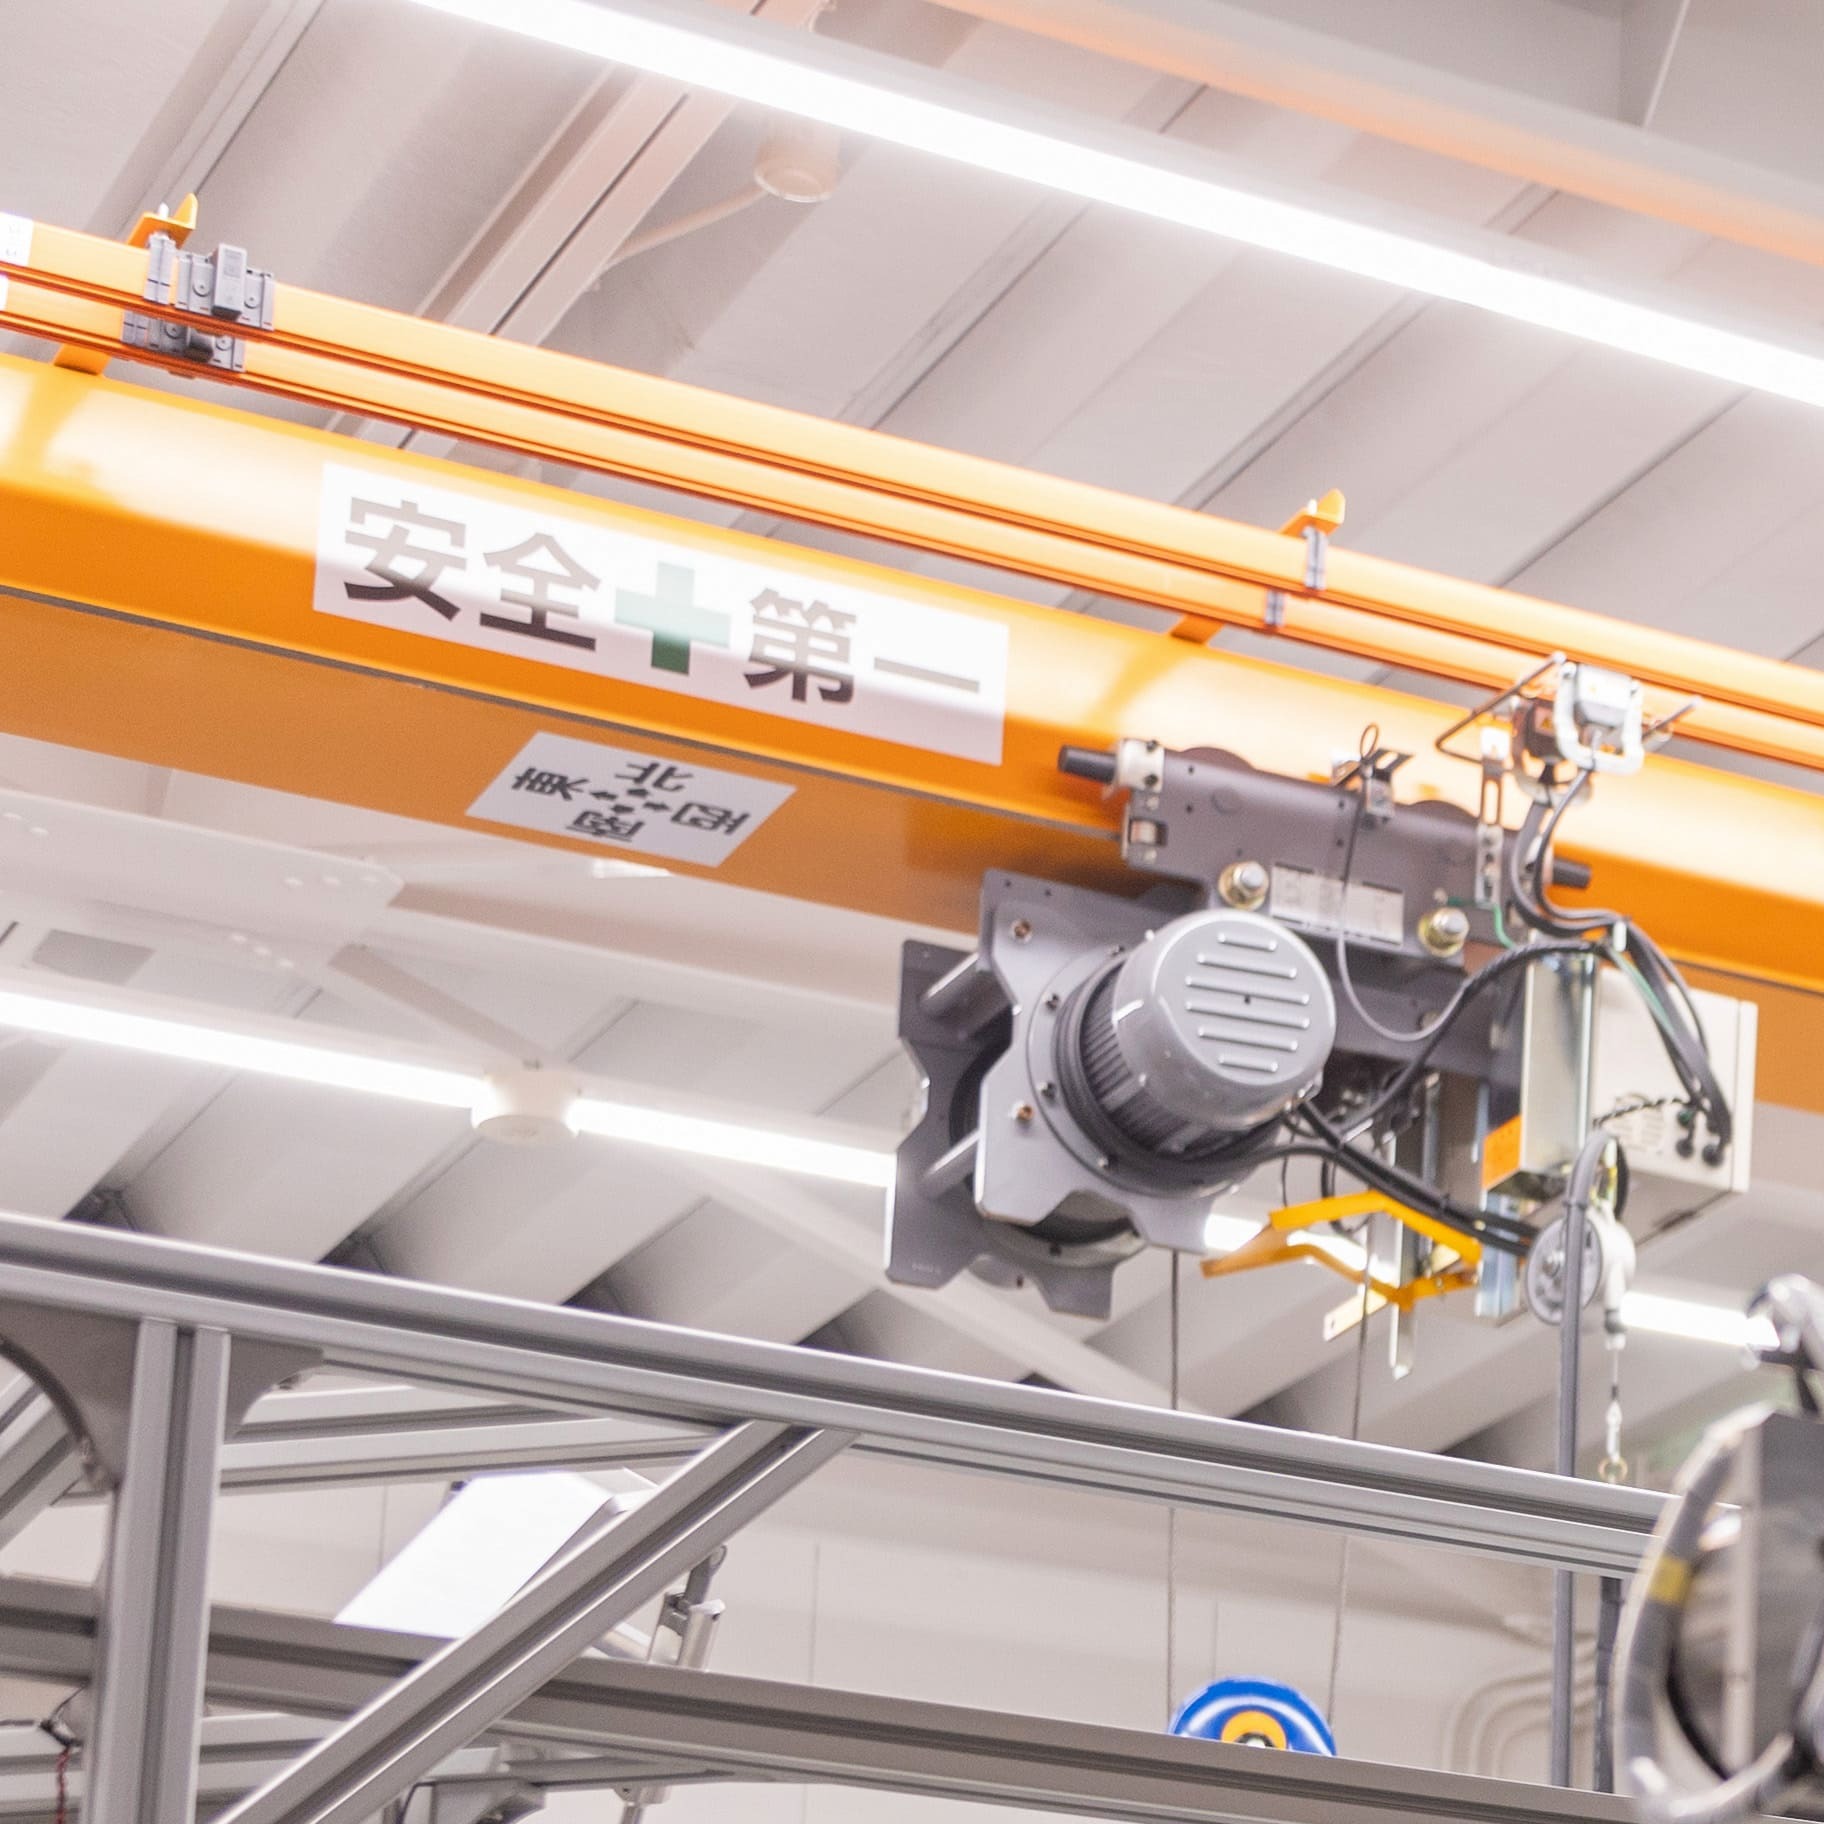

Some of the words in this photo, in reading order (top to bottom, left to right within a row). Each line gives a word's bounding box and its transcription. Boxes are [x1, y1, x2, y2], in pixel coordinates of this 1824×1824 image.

[343, 496, 601, 652] 安全
[743, 587, 981, 704] 第一
[511, 767, 589, 801] 東
[670, 802, 751, 836] 西
[615, 762, 693, 792] 北
[566, 810, 645, 843] 南
